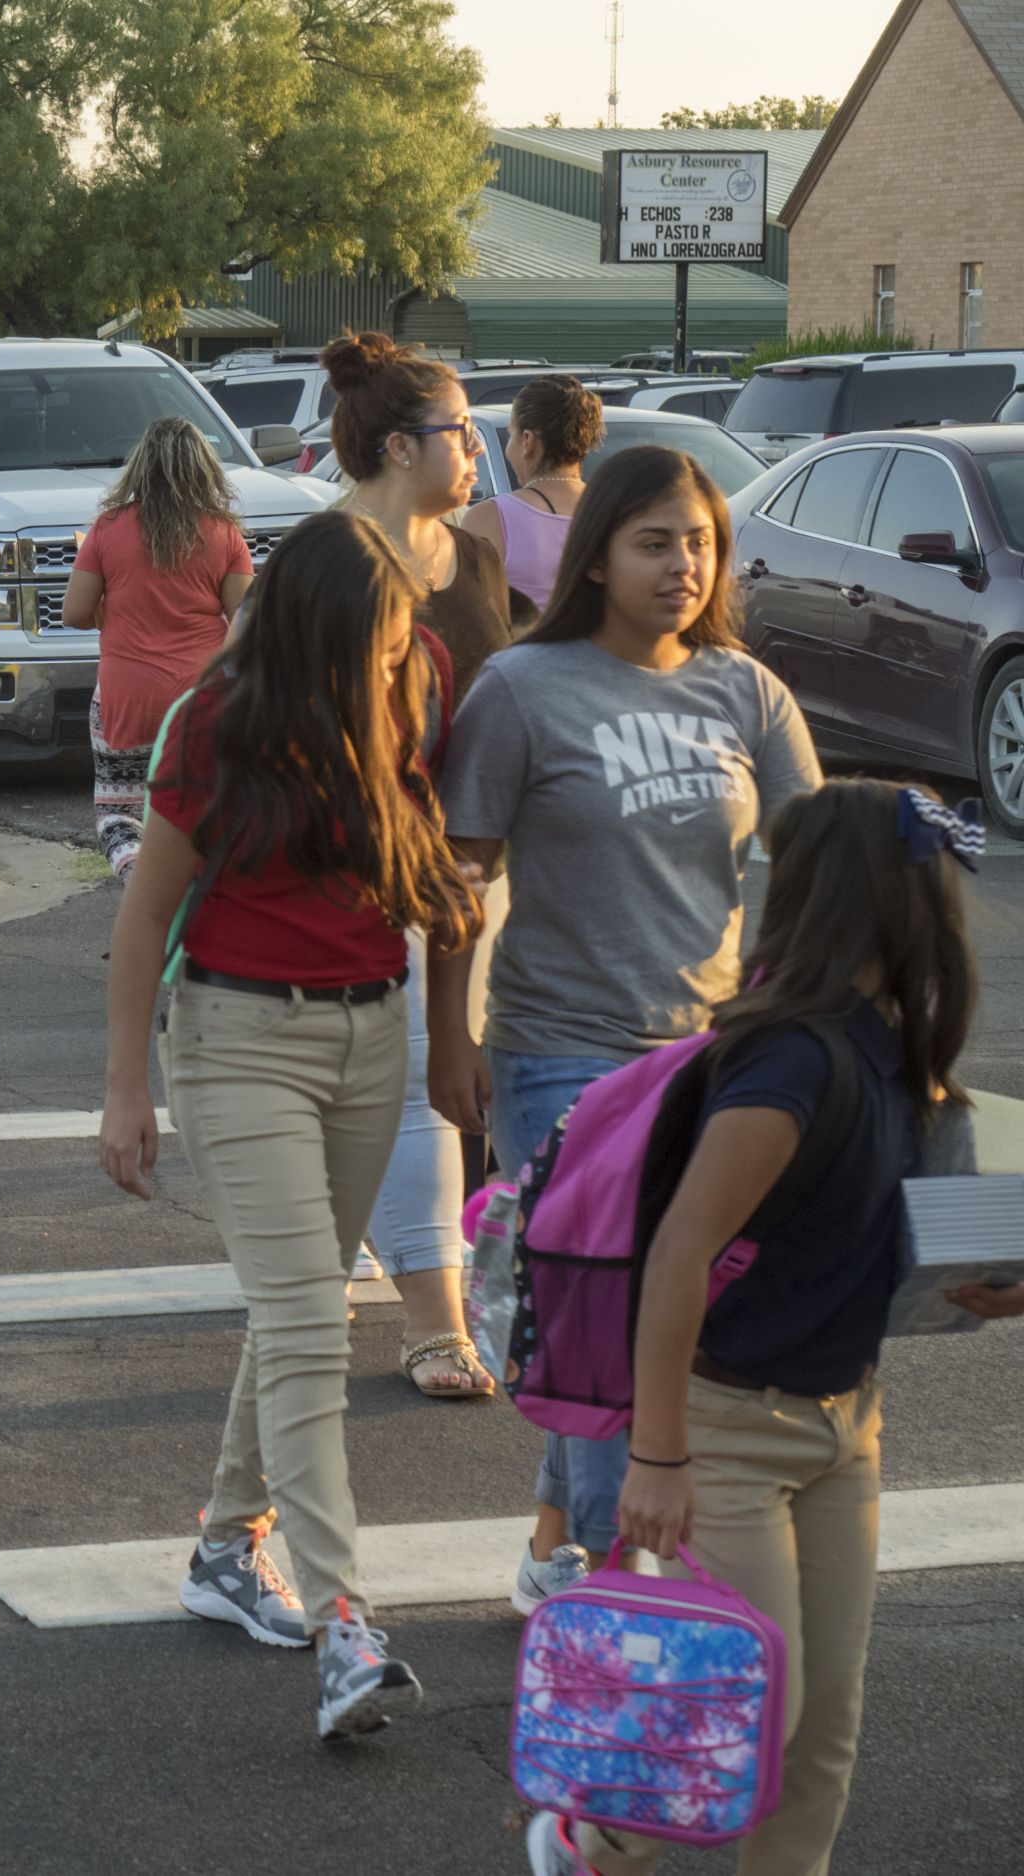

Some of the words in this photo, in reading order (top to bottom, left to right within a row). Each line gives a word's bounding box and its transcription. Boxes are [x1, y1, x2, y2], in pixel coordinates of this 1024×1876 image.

[627, 154, 677, 171] Asbury
[680, 154, 742, 169] Resource
[660, 173, 707, 187] Center
[640, 207, 681, 221] ECHOS
[631, 243, 657, 258] HNO
[592, 712, 756, 788] NIKE
[620, 772, 748, 818] ATHLETICS
